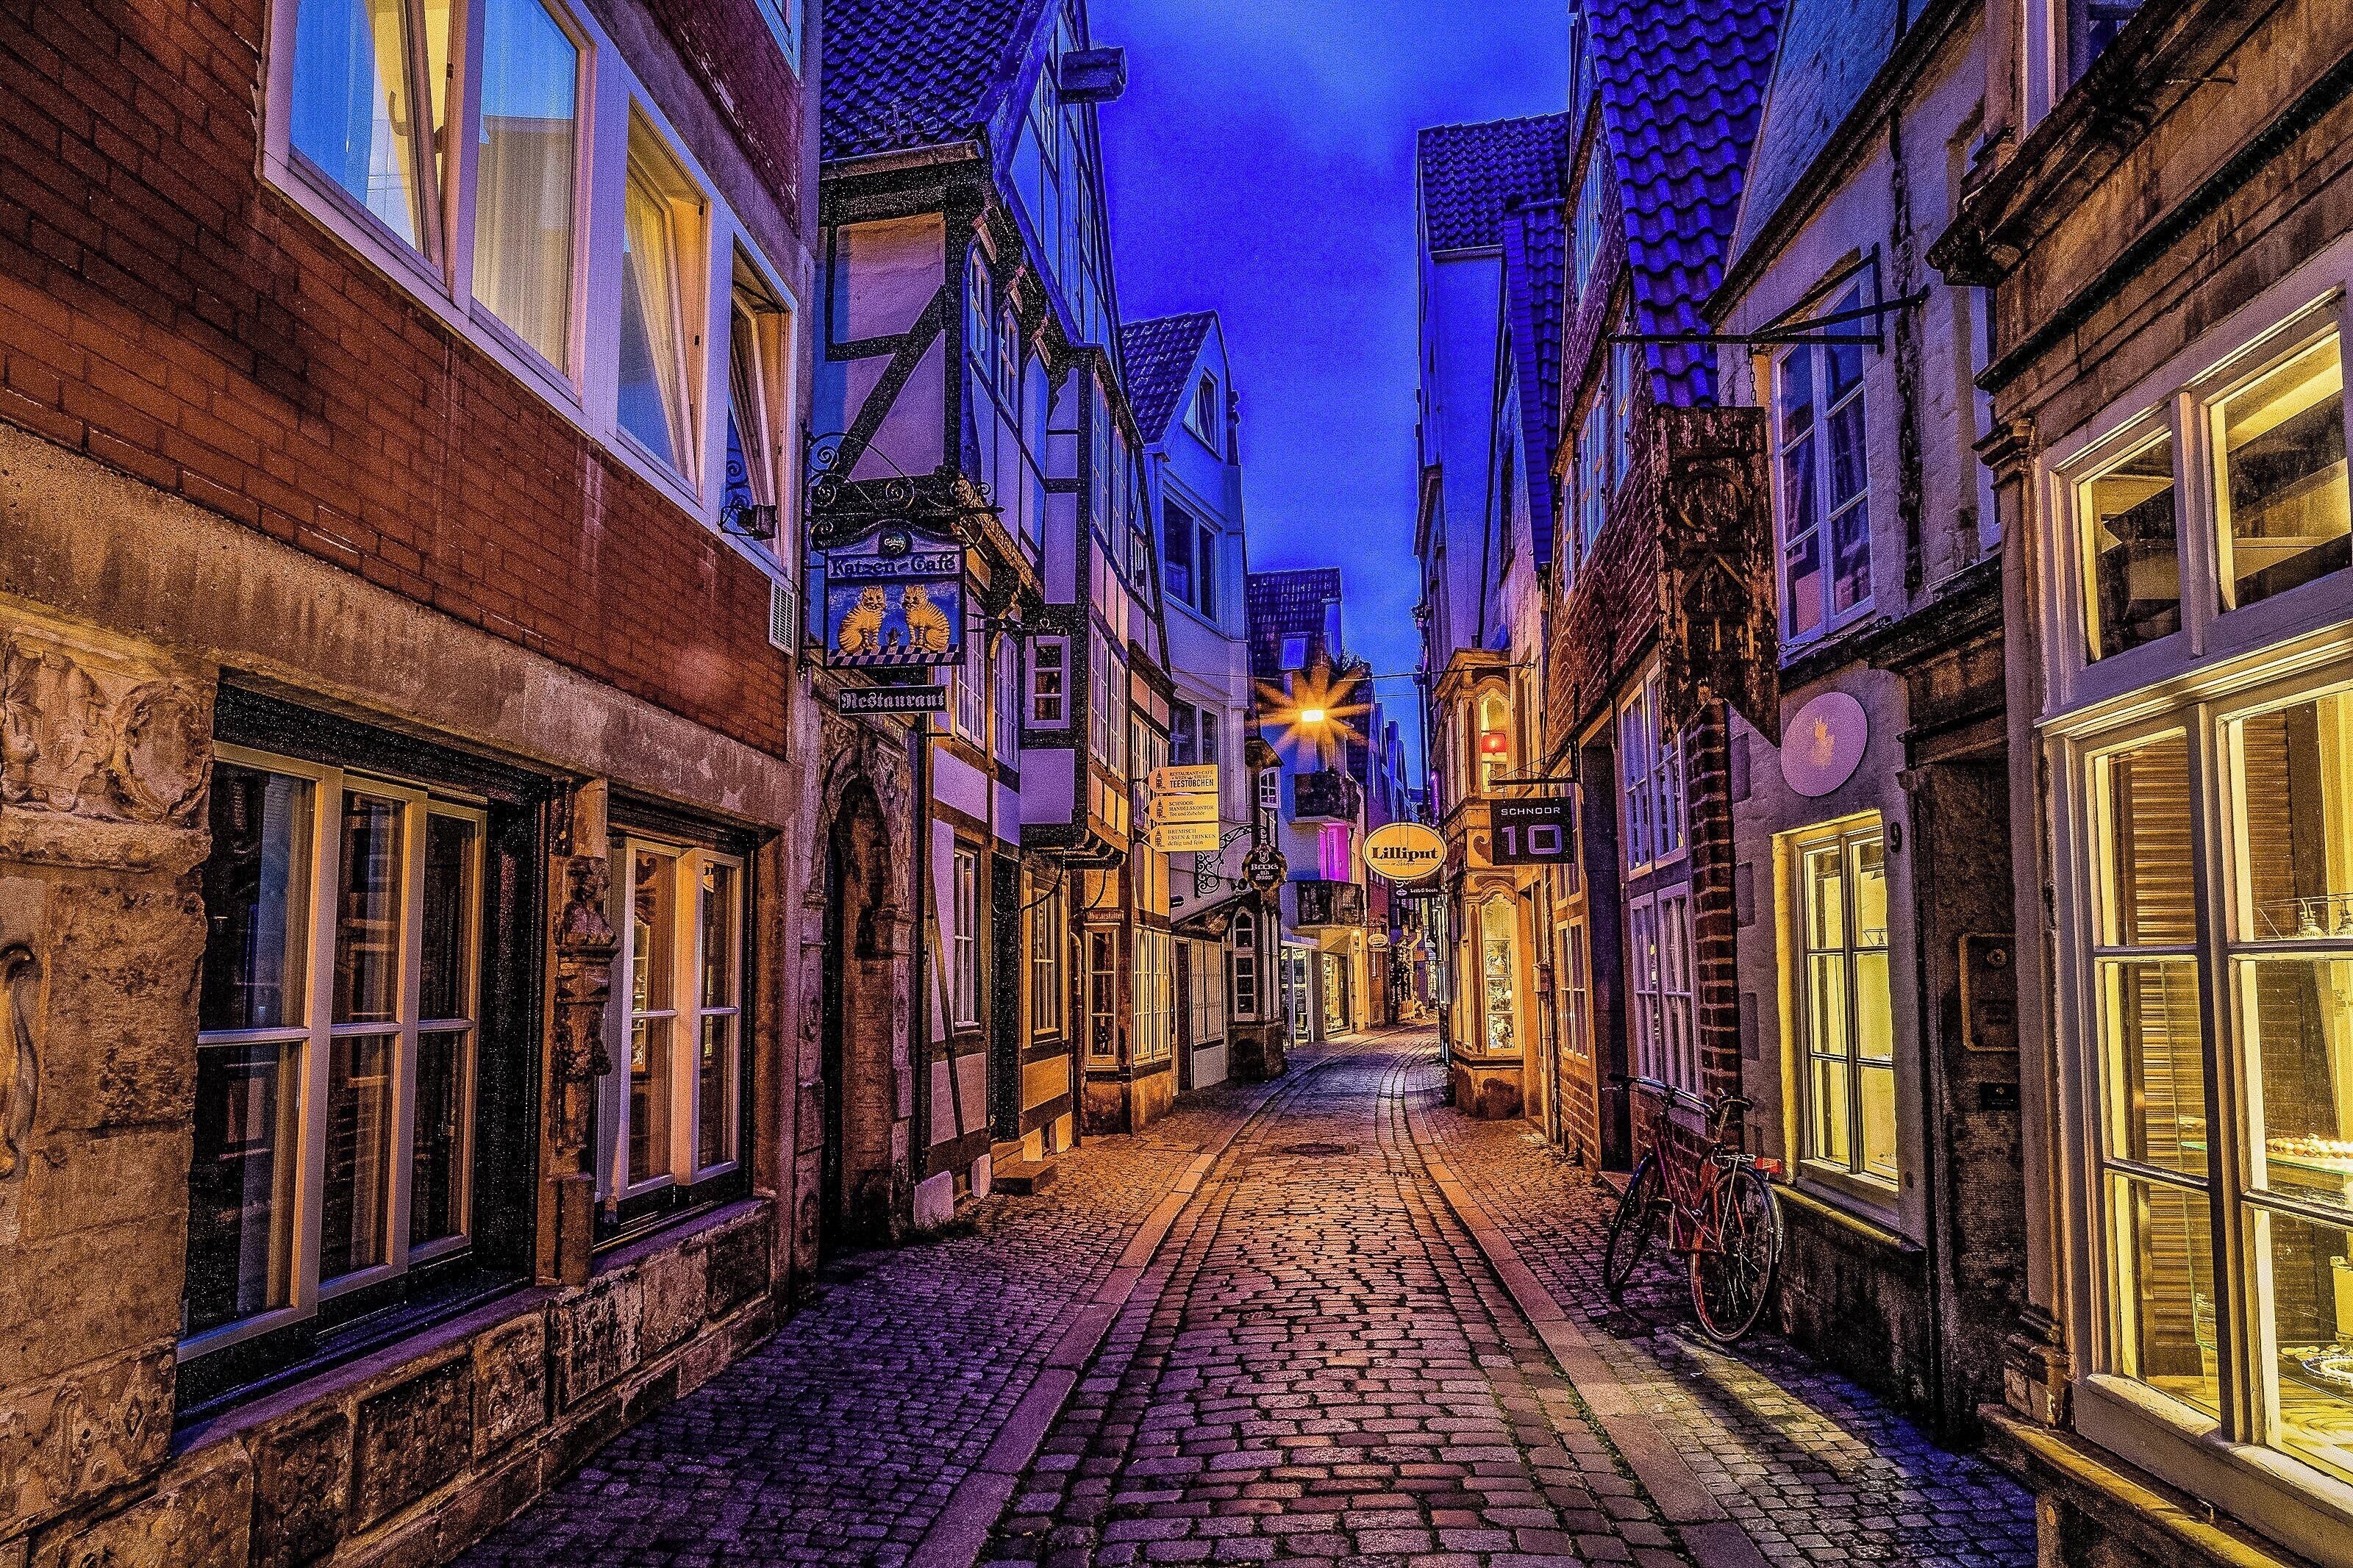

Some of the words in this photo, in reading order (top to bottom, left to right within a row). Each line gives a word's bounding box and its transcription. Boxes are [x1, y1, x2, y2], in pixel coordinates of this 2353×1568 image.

[840, 692, 946, 709] Restaurant
[1501, 806, 1560, 816] SCHNOOR
[1502, 824, 1563, 856] 10
[1890, 821, 1902, 853] 9
[1371, 846, 1439, 863] Lilliput
